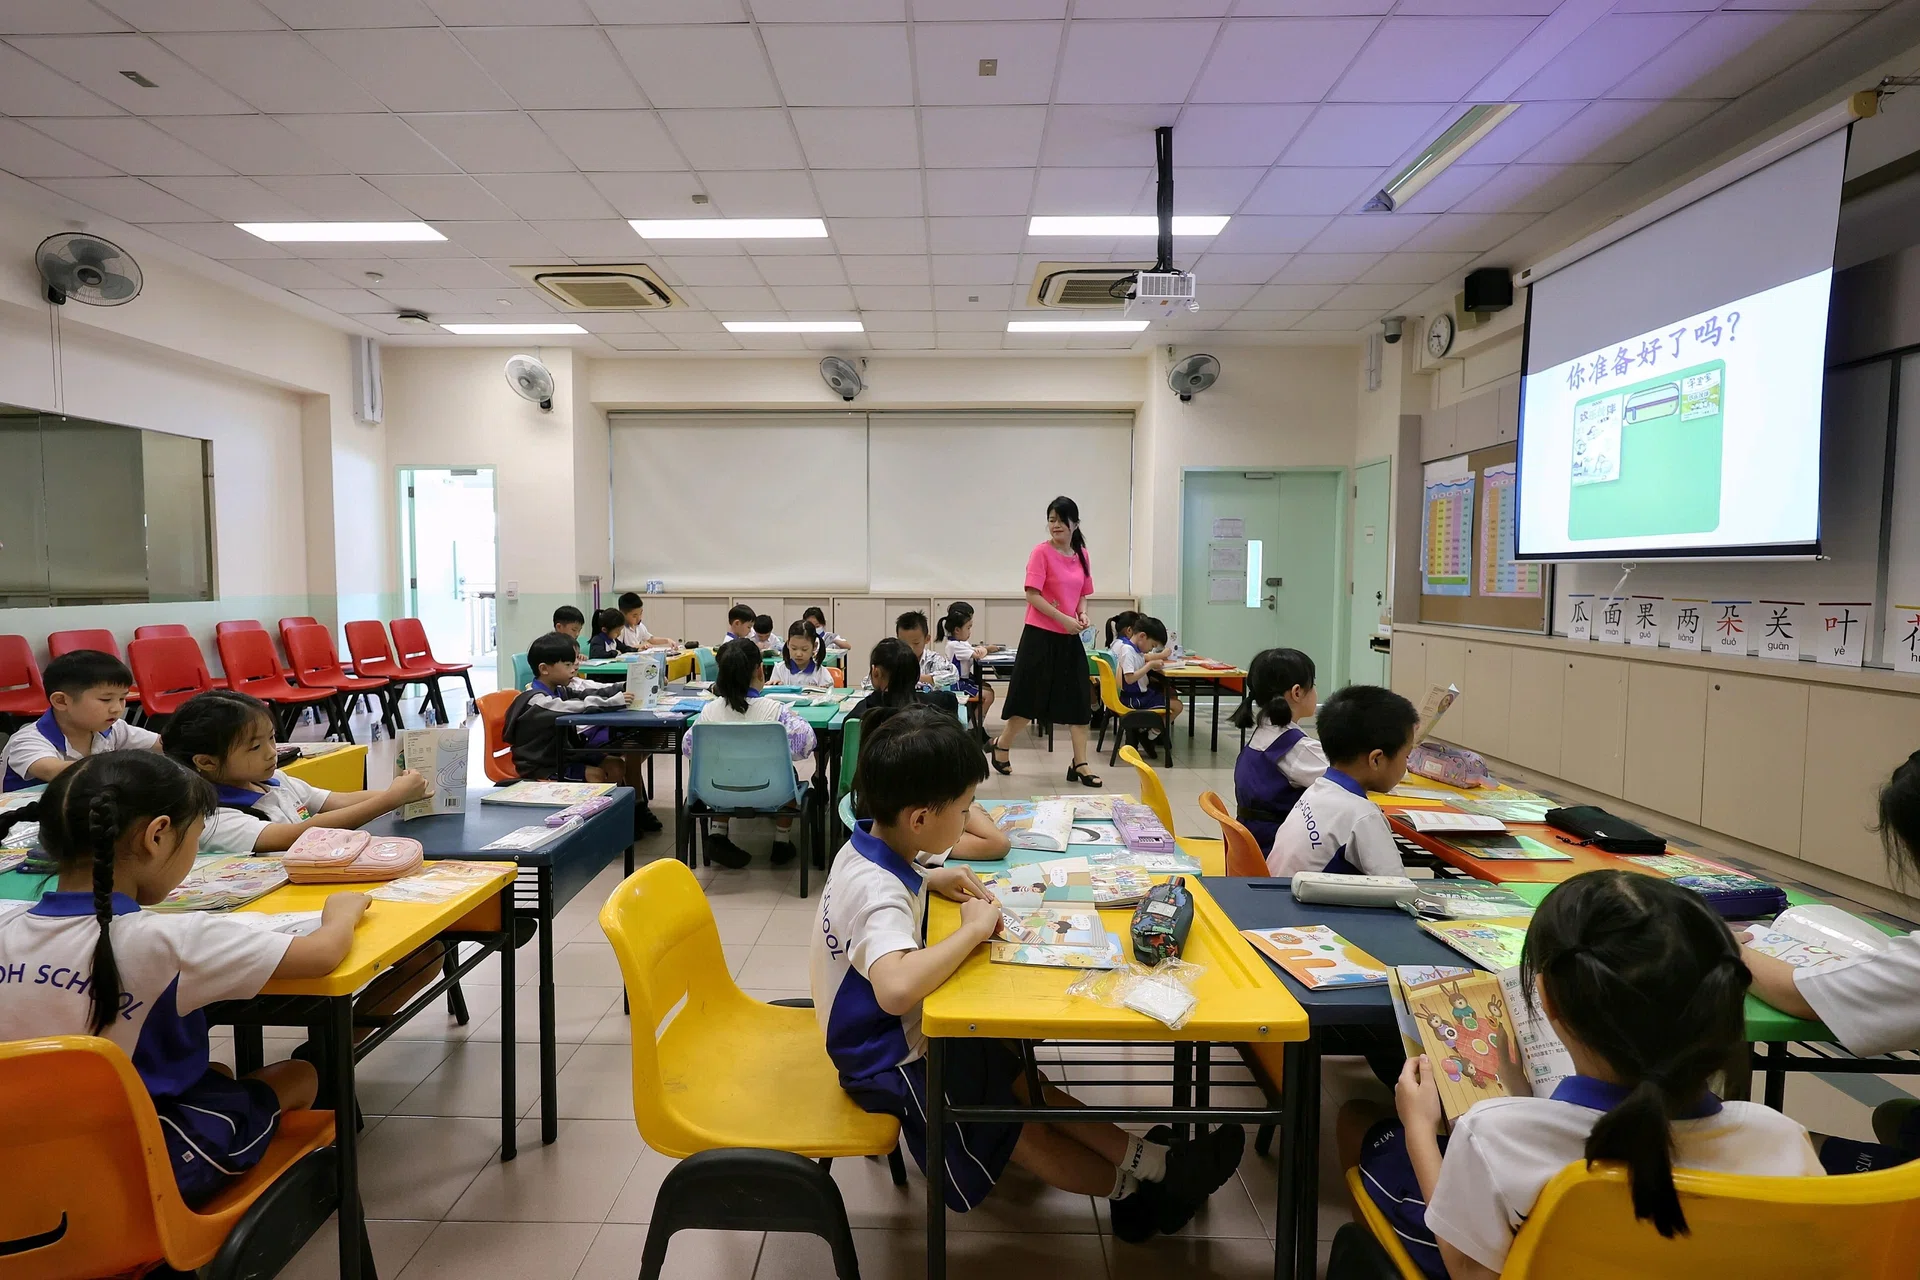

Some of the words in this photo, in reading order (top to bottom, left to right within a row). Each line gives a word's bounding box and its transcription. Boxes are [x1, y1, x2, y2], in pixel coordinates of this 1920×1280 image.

[1566, 311, 1741, 391] 你准备好了吗?
[1571, 601, 1589, 623] 瓜
[1604, 602, 1622, 626] 面
[1636, 603, 1657, 629] 果
[1678, 607, 1699, 634] 两
[1716, 605, 1744, 636] 朵
[1765, 606, 1793, 639] 关
[1825, 608, 1858, 646] 叶
[1834, 646, 1846, 656] yè
[1301, 802, 1322, 850] SCHOOL
[34, 964, 143, 1020] SCHOL
